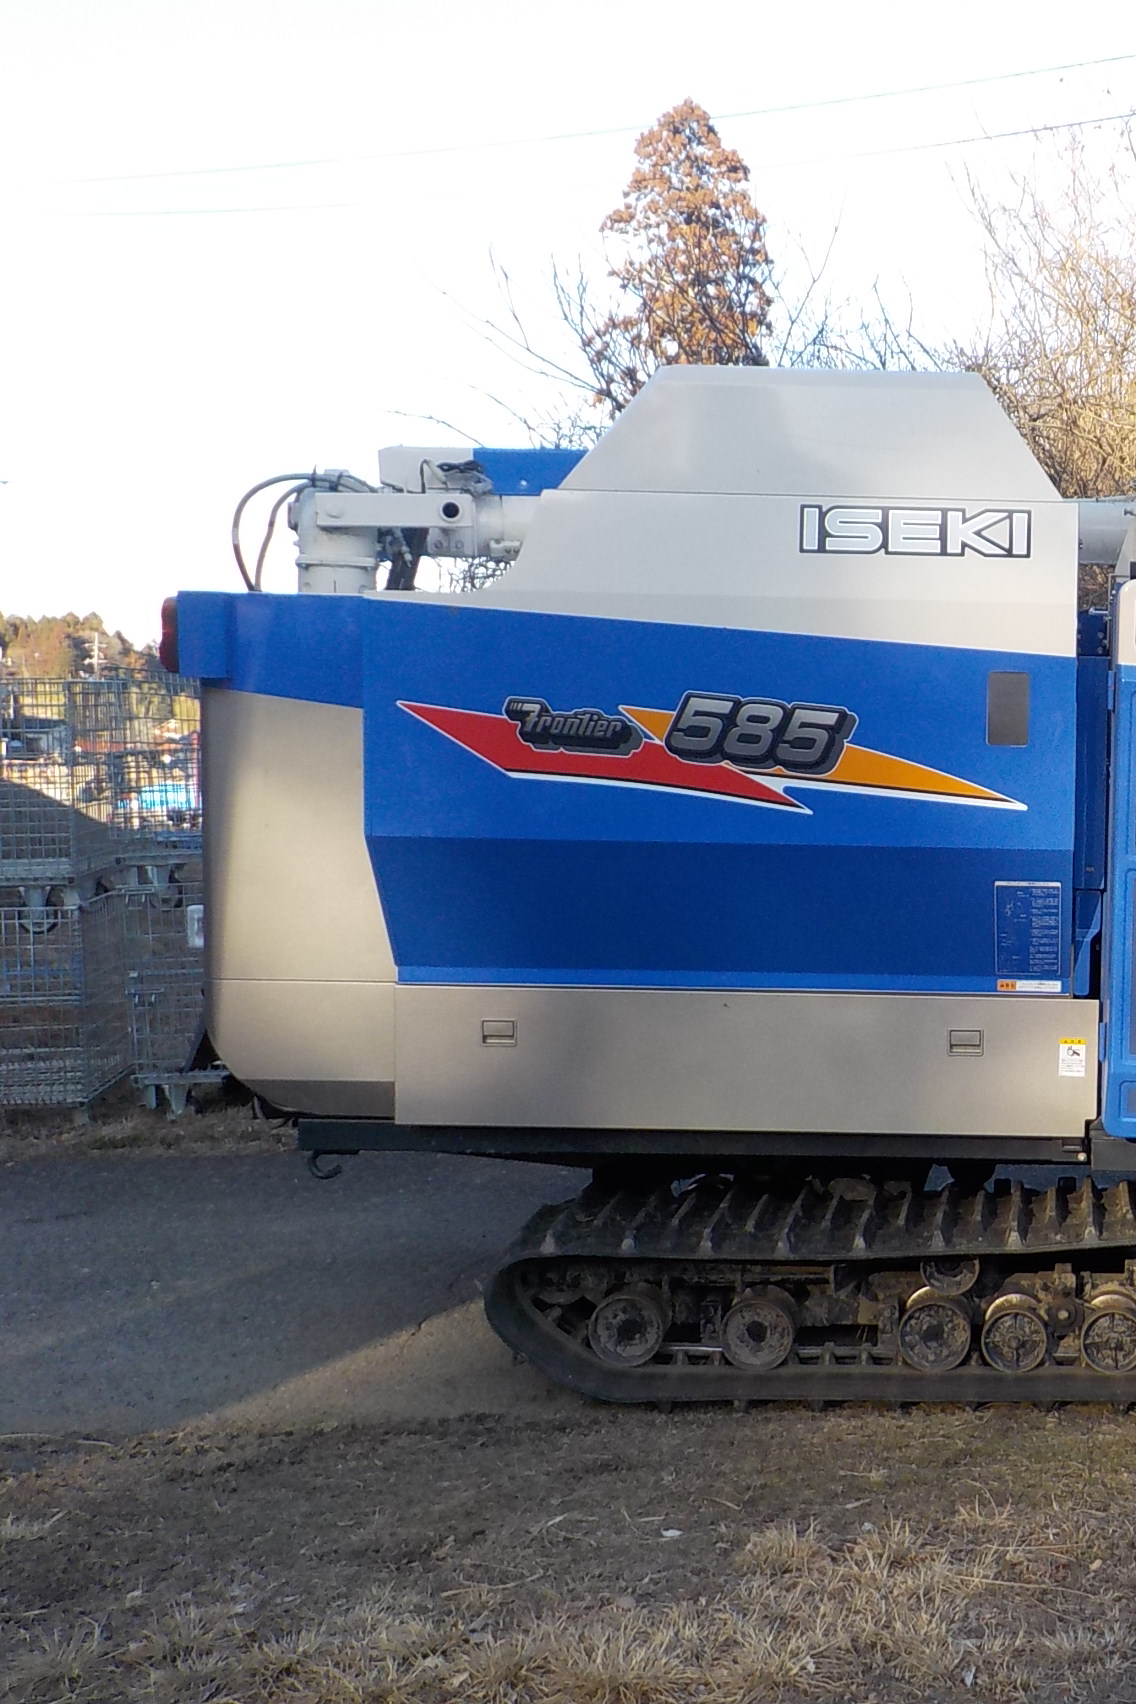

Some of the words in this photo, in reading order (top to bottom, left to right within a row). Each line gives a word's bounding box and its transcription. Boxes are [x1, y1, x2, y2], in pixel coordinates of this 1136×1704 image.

[799, 504, 1031, 558] ISEKI
[509, 700, 625, 741] Frontier
[669, 695, 842, 764] 585
